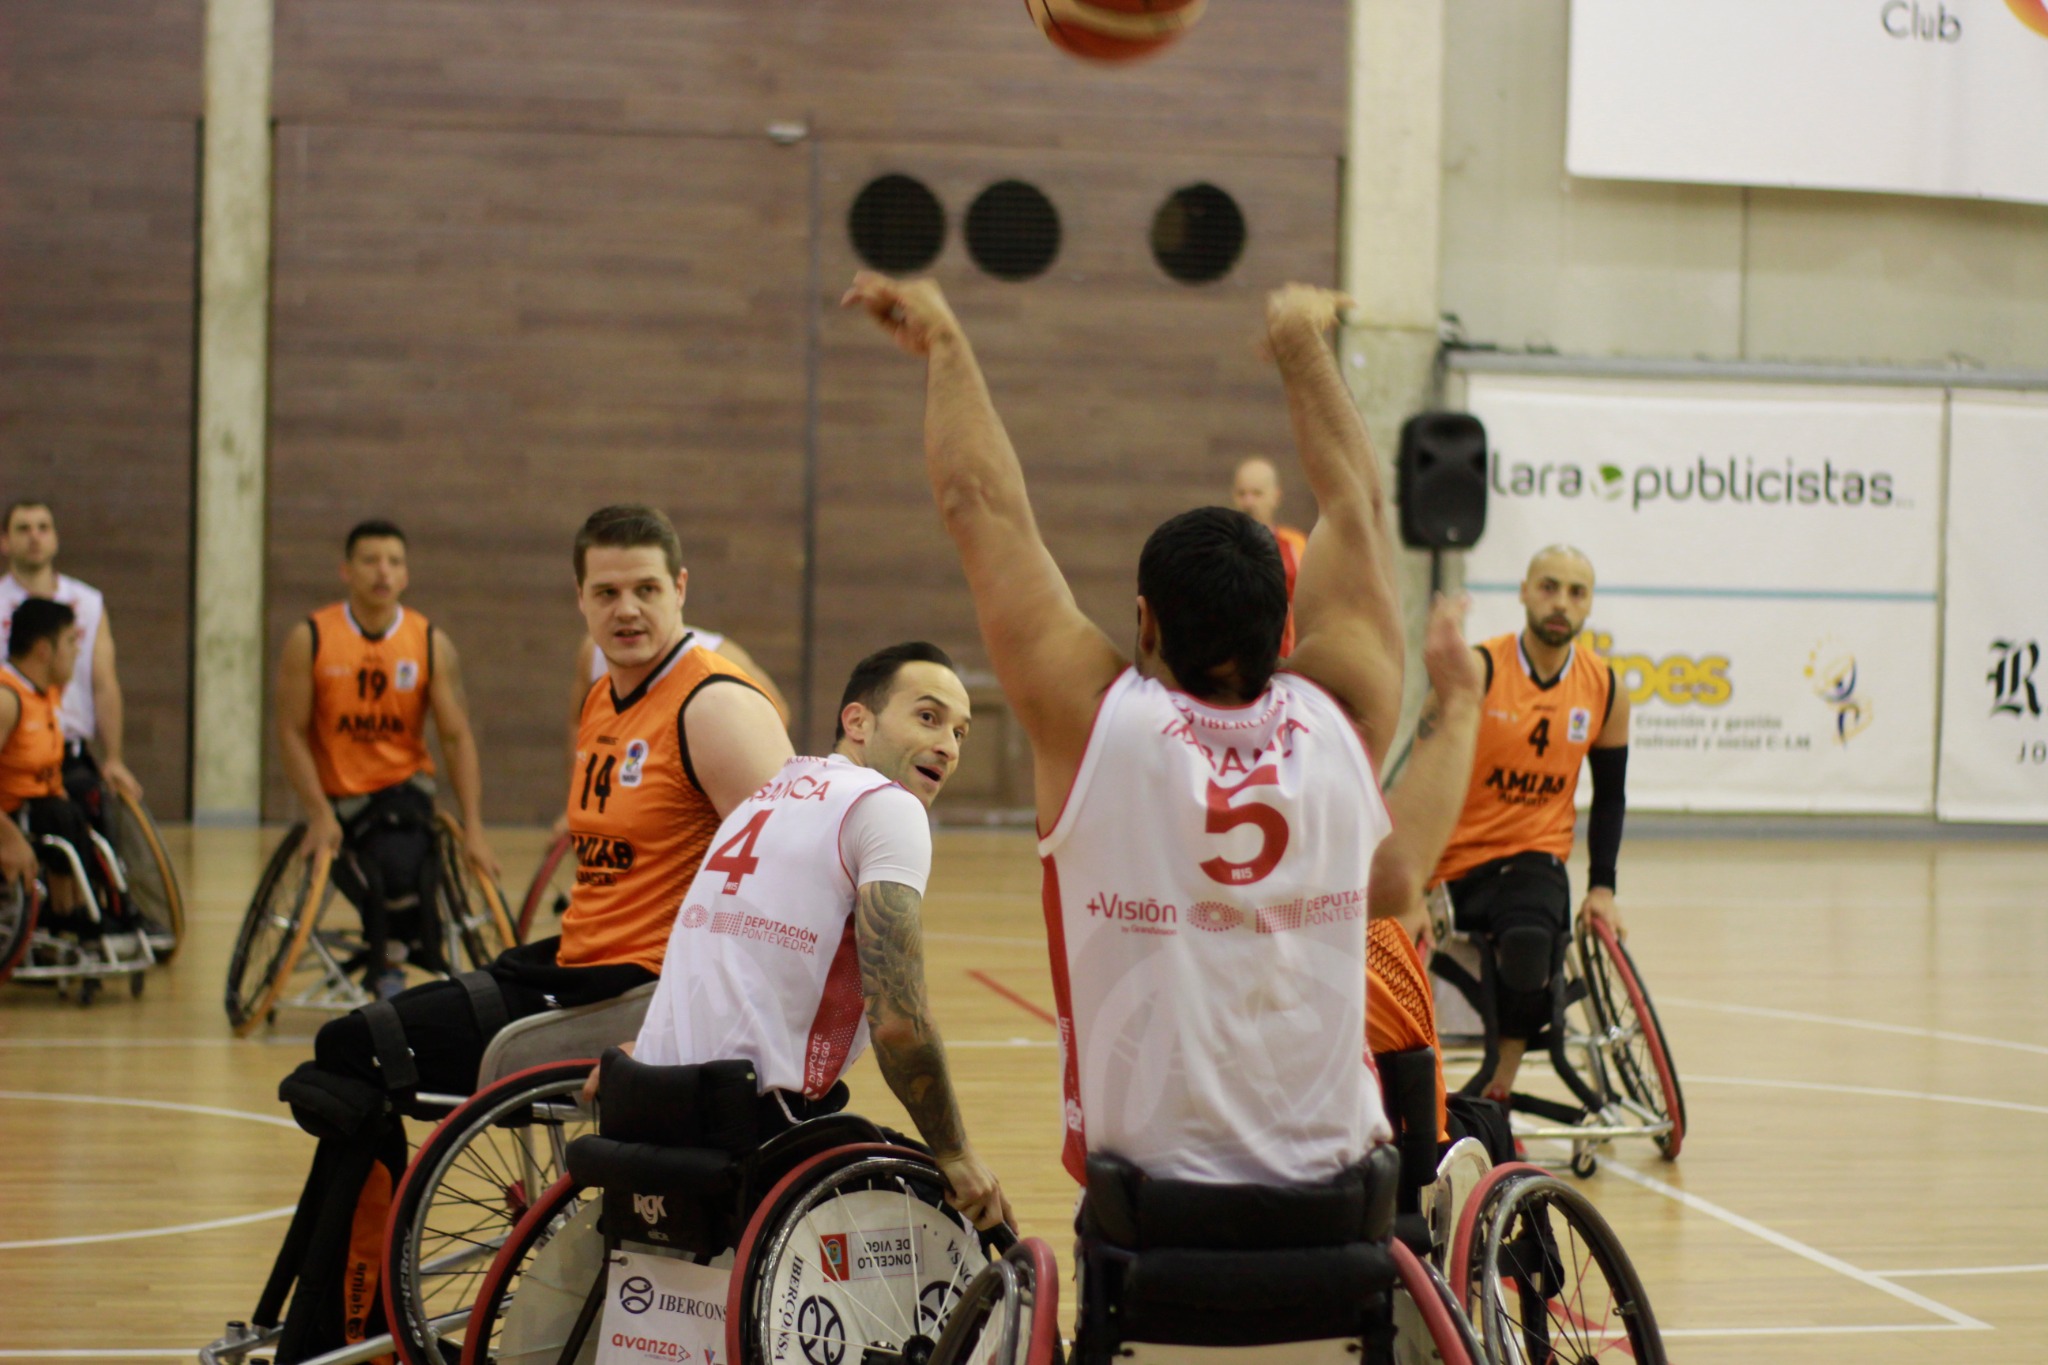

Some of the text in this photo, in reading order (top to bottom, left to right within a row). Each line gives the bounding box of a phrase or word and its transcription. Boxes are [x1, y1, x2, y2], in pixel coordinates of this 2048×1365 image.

[1881, 0, 1962, 43] Club
[1632, 455, 1894, 512] publicistas
[357, 667, 388, 700] 19
[1986, 638, 2041, 718] R
[1528, 717, 1550, 757] 4
[580, 752, 617, 814] 14
[1199, 763, 1290, 886] 5
[704, 808, 775, 895] 4
[741, 926, 815, 956] PONTEVEDRA
[744, 915, 818, 945] DEPUTACIÓN
[808, 1032, 823, 1084] DEPORTE
[816, 1041, 831, 1087] GALEGO
[858, 1252, 919, 1270] CONCELLO
[863, 1238, 911, 1253] DE VIGO
[775, 1255, 804, 1362] IBERCONSA
[611, 1333, 678, 1357] avanza
